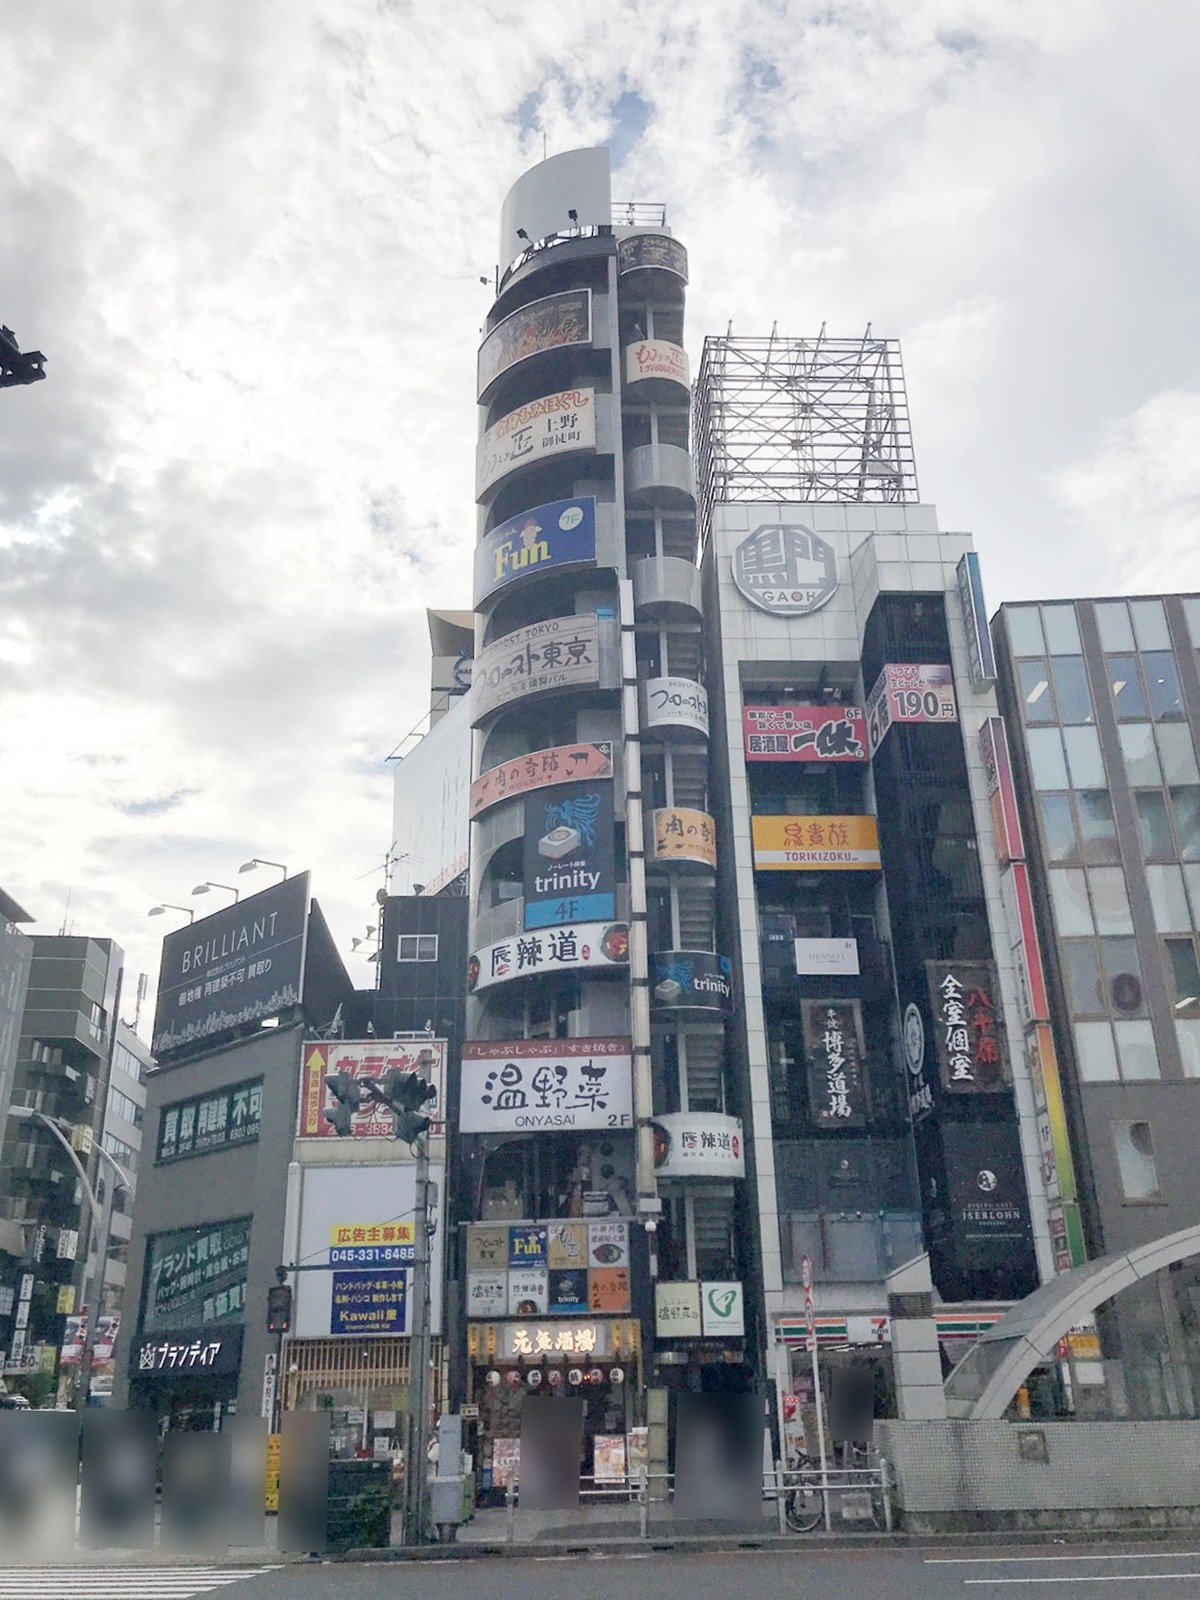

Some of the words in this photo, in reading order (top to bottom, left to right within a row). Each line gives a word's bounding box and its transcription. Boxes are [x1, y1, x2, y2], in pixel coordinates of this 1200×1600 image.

[493, 540, 552, 582] Fun
[762, 591, 816, 602] GAOH
[524, 622, 560, 638] TOKYO
[845, 709, 861, 719] 6F
[892, 691, 954, 718] 190円
[749, 734, 790, 754] 居酒屋
[665, 815, 714, 844] 肉の奇
[783, 822, 849, 847] 鳥貴族
[784, 851, 851, 862] TORIKIZOKU
[535, 869, 601, 893] trinity
[555, 900, 580, 920] 4F
[182, 912, 278, 973] BRILLIANT
[248, 958, 272, 980] 買取り
[694, 978, 730, 998] trinity
[940, 974, 974, 1081] 全室個室
[481, 1060, 609, 1112] 温野菜
[515, 1114, 575, 1127] ONYASAI
[608, 1114, 630, 1127] 2F
[962, 1210, 1020, 1221] ISERLOHN
[338, 1226, 410, 1243] 広告主募集
[513, 1238, 542, 1255] Fun
[557, 1296, 579, 1304] trinity
[340, 1310, 384, 1322] Kawaii
[158, 1340, 221, 1369] ブランディア
